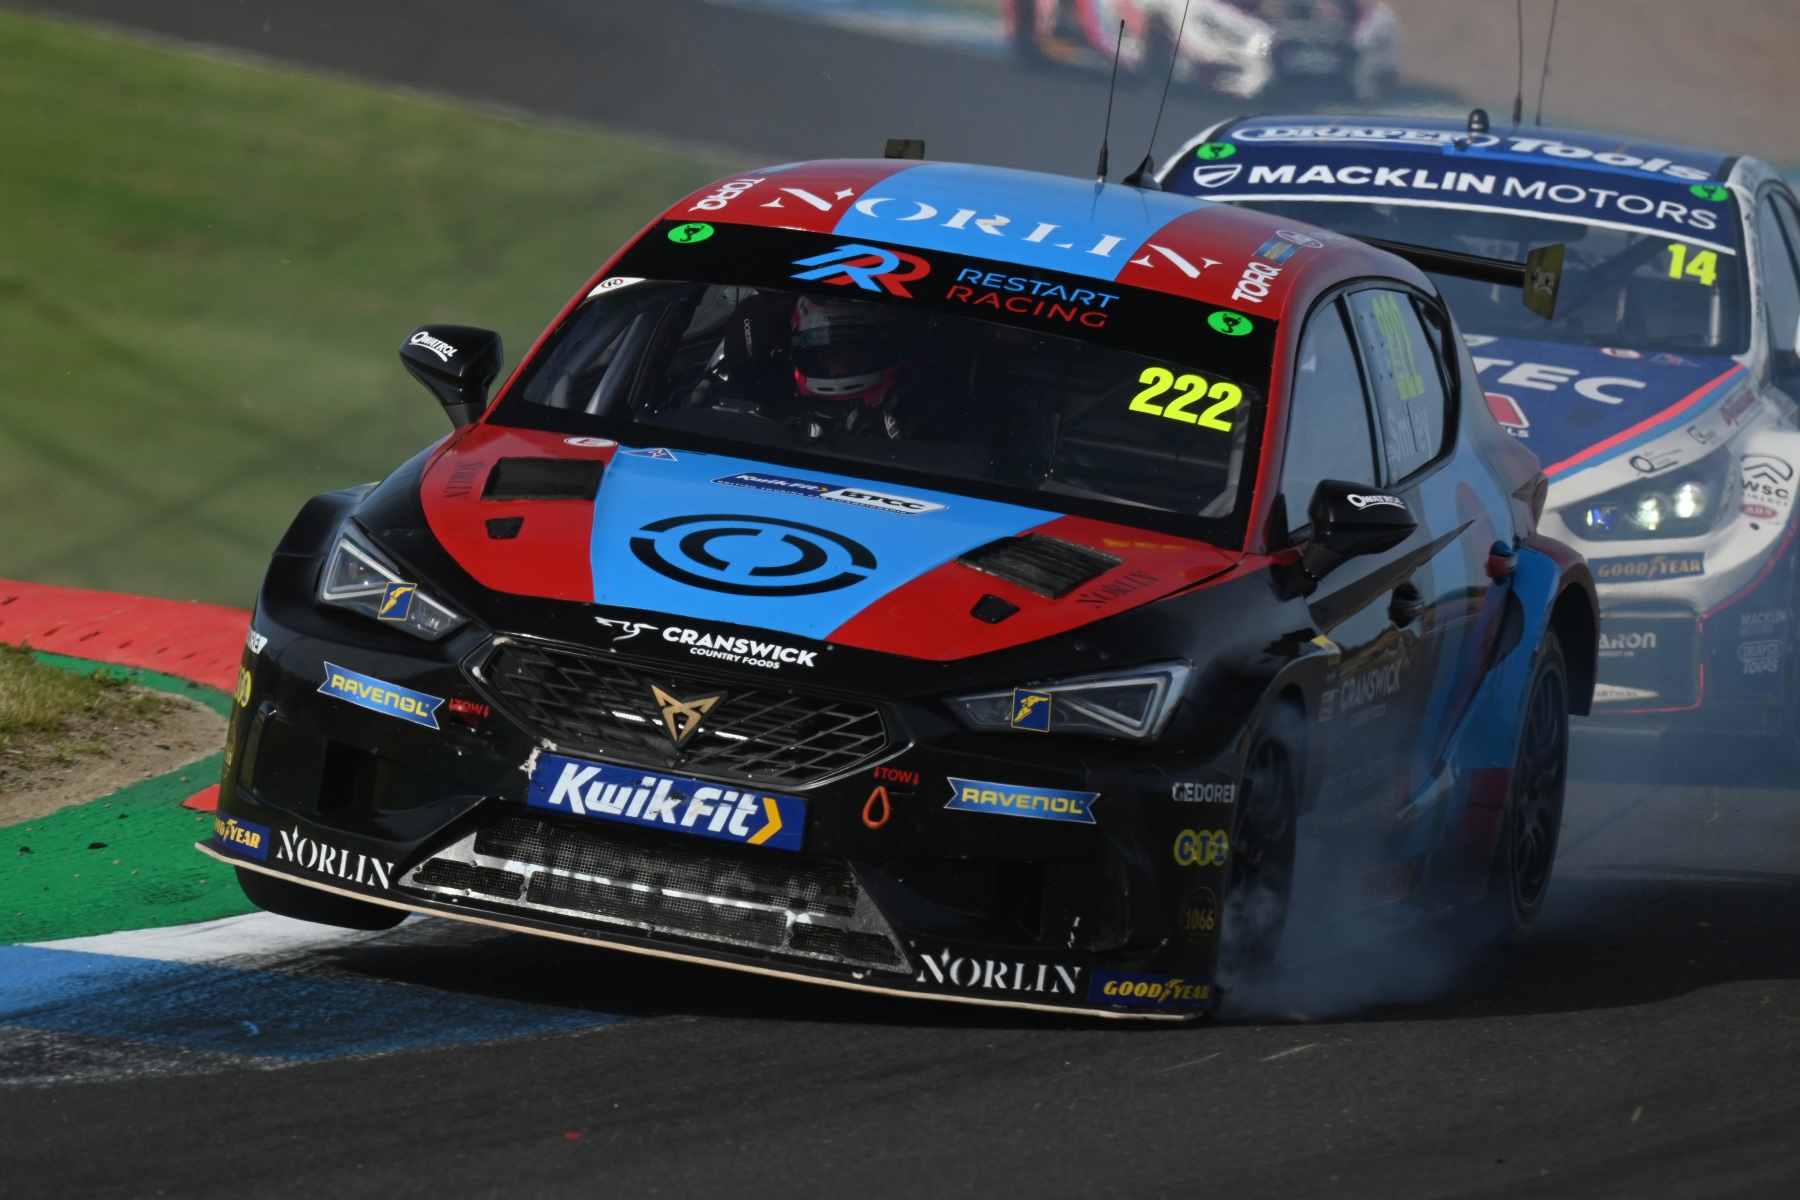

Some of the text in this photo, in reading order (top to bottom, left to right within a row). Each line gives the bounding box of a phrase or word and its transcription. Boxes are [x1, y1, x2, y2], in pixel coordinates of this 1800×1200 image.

[1508, 136, 1711, 181] Tools
[687, 177, 766, 213] TORQ
[1248, 165, 1718, 230] MACKLIN MOTORS
[1230, 261, 1283, 304] TORQ
[1668, 243, 1718, 287] 14
[945, 284, 1109, 328] RACING
[956, 267, 1119, 309] RESTART
[1129, 367, 1244, 433] 222
[839, 490, 926, 510] BTCC
[1741, 478, 1789, 500] WSC
[662, 626, 818, 667] CRANSWICK
[690, 647, 780, 670] COUNTRY FOODS
[331, 674, 428, 718] RAVENOL
[881, 767, 914, 783] TOW
[548, 763, 759, 837] Kwik Fit
[961, 787, 1084, 815] RAVENOL
[276, 825, 395, 890] NORLIN
[1184, 908, 1216, 931] 1066
[916, 947, 1082, 994] NORLIN
[1103, 978, 1210, 1003] GOODYEAR
